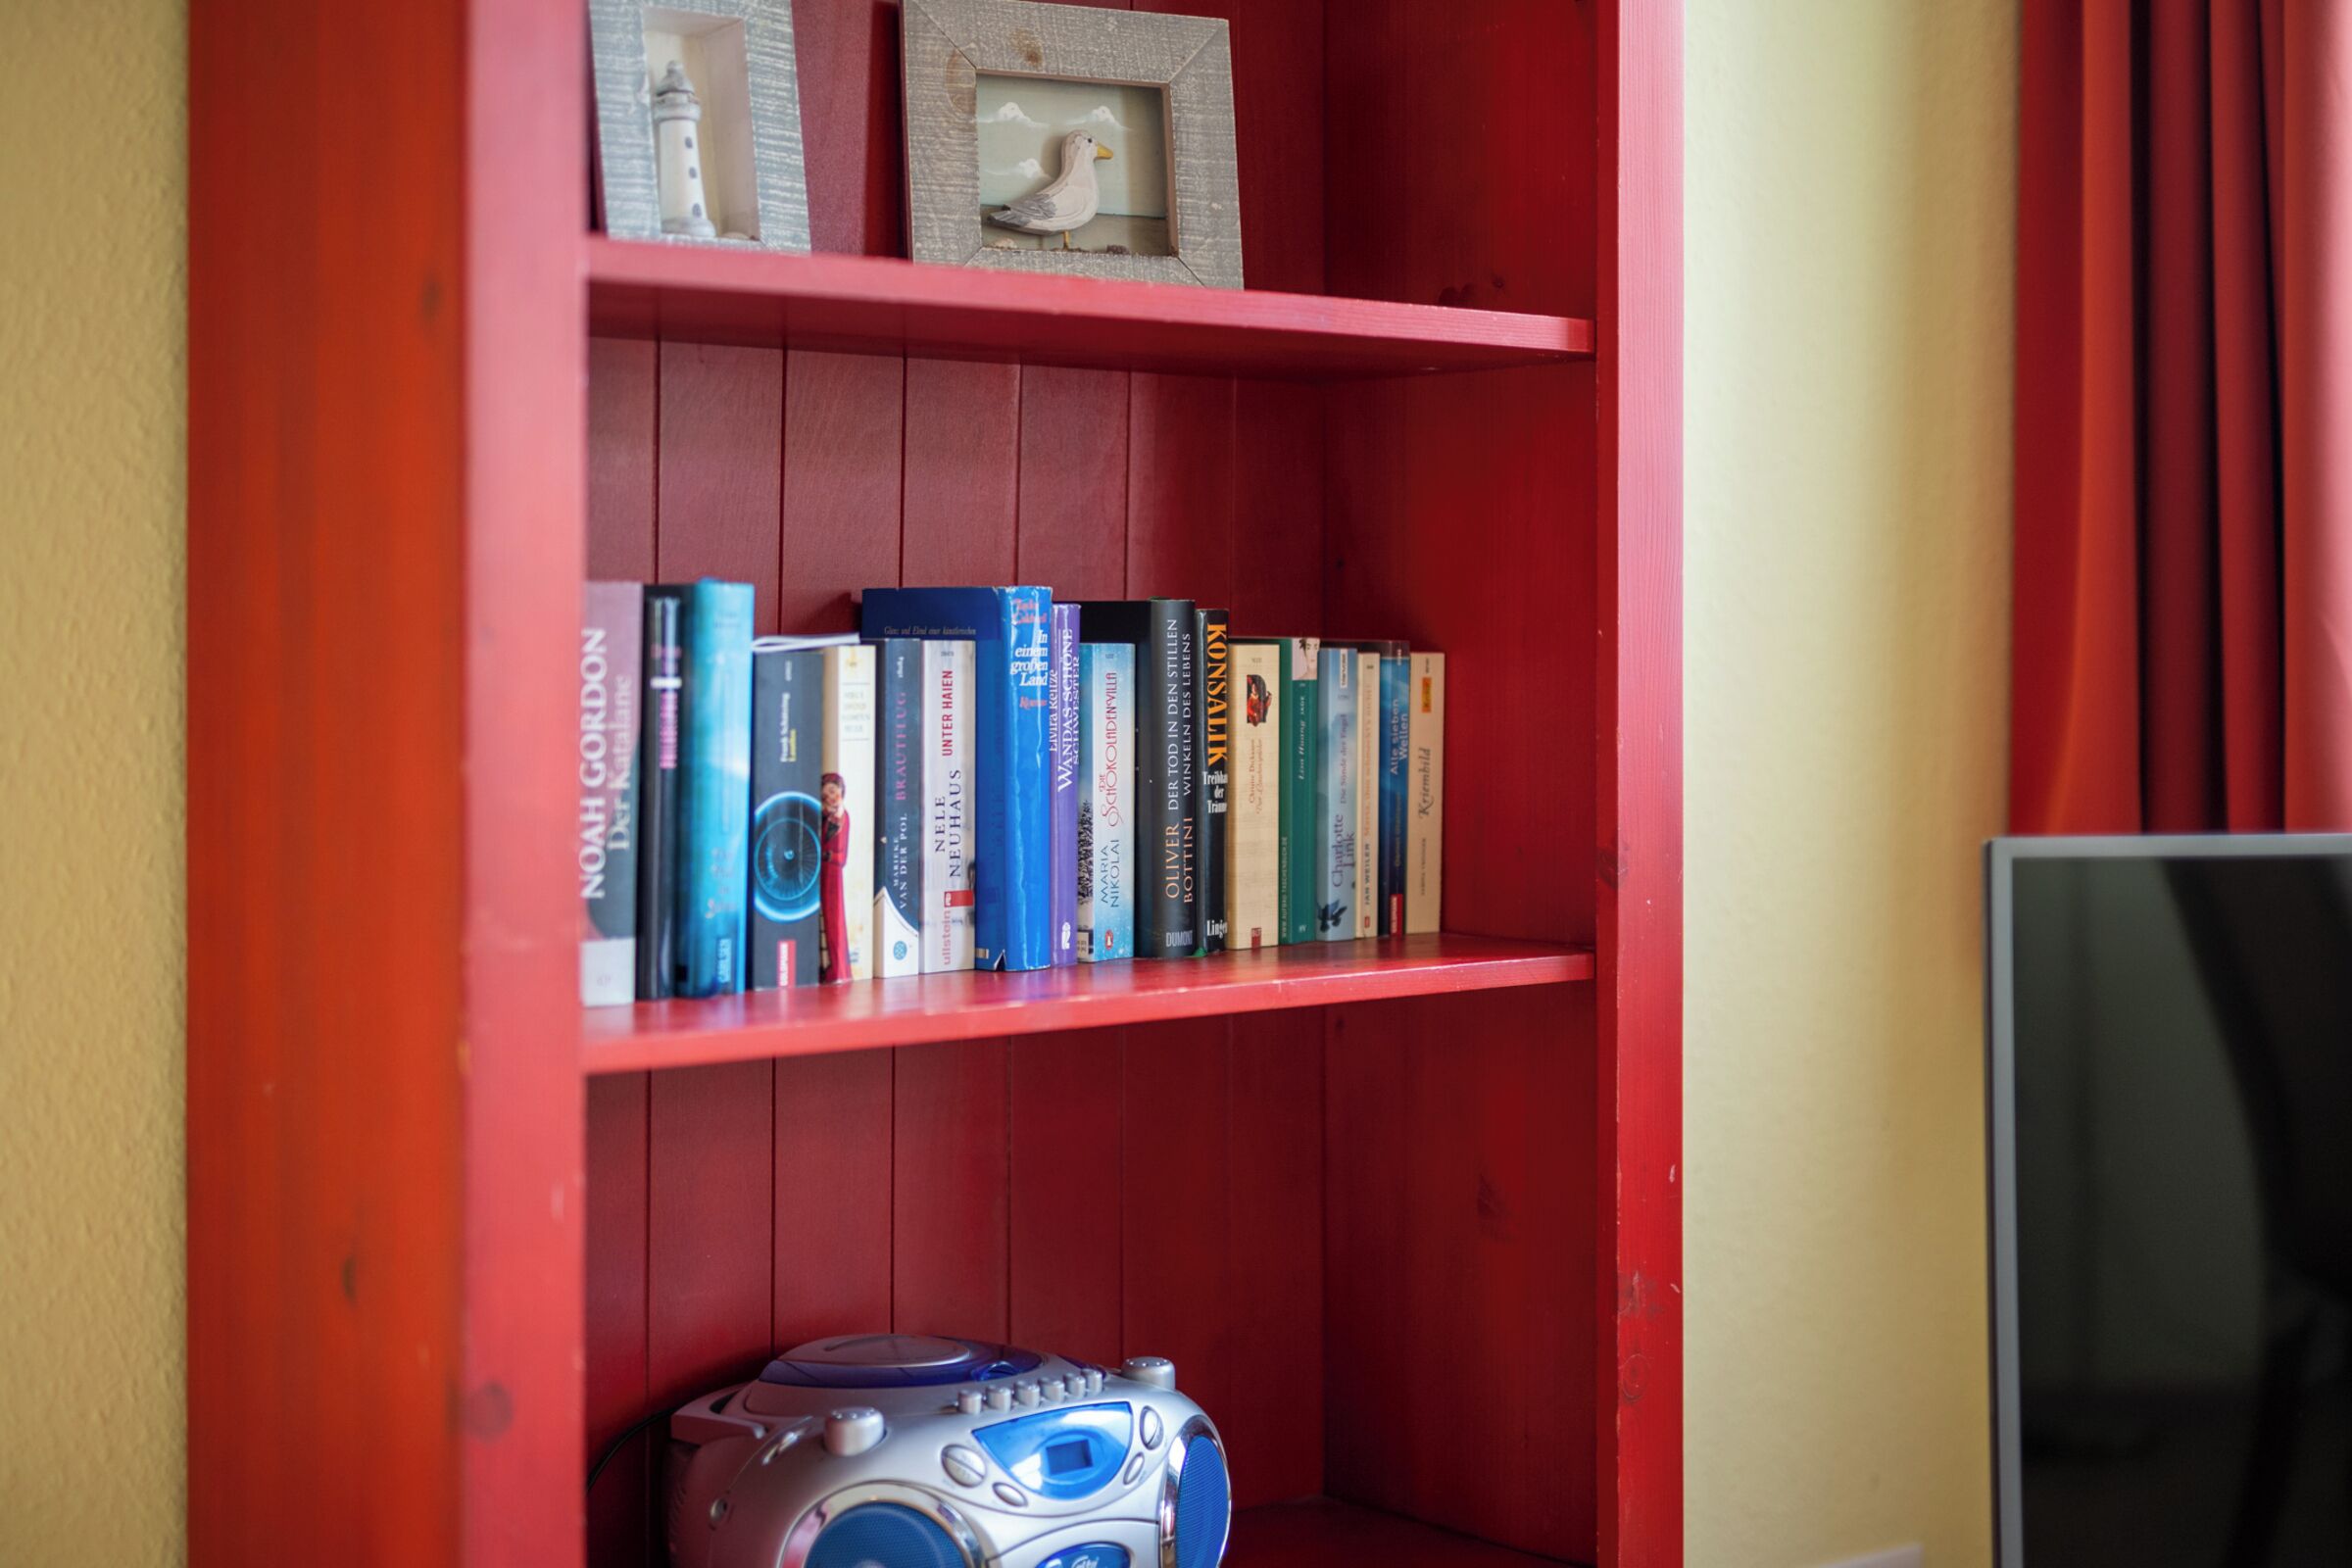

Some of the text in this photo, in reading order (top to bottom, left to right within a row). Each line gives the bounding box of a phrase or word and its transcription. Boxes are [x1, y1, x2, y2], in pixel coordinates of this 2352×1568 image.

[1009, 658, 1048, 674] großen
[1014, 644, 1048, 658] einem
[1037, 629, 1048, 644] In
[941, 670, 954, 710] HAIEN
[1019, 671, 1048, 686] Land
[1206, 623, 1228, 767] KONSALIK
[941, 713, 954, 757] UNTER
[1057, 628, 1073, 792] WANDAS SCHÖNE
[1167, 619, 1179, 810] DER TOD IN DEN STILLEN
[1182, 633, 1192, 796] WINKELN DES LEBENS
[1340, 714, 1349, 739] Engel
[1390, 699, 1399, 745] sieben
[1399, 713, 1409, 760] Wellen
[578, 627, 608, 899] NOAH GORDON
[606, 674, 632, 850] Der Katalane
[895, 691, 906, 802] BRAUTFLUG
[1101, 672, 1124, 827] SCHOKOLADENVILLA
[1214, 785, 1224, 799] der
[934, 796, 946, 853] NELE
[949, 769, 962, 878] NEUHAUS
[1331, 814, 1345, 888] Charlotte
[1343, 831, 1355, 868] Link
[899, 812, 907, 909] VAN DER POL
[1101, 845, 1109, 904] MARIA
[1109, 839, 1120, 907] NIKOLAI
[1165, 823, 1180, 899] OLIVER
[1183, 817, 1194, 903] BOTTINI
[942, 909, 952, 966] ullstein
[1165, 930, 1193, 948] DUMONT
